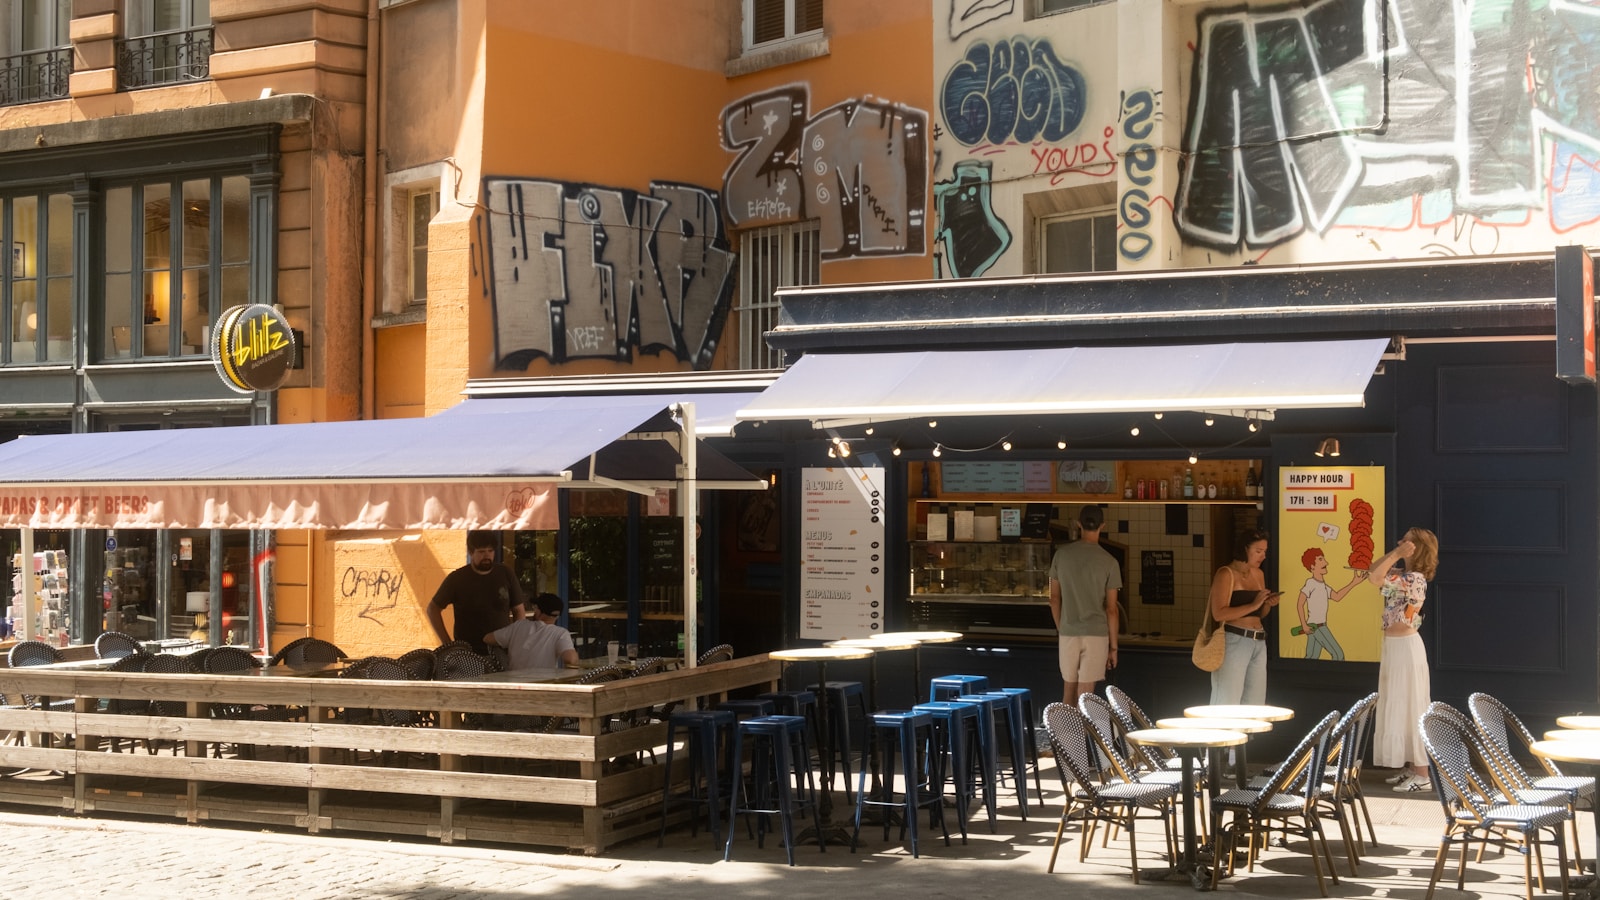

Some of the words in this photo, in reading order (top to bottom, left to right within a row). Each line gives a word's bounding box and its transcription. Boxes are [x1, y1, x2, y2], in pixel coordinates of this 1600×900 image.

[233, 312, 289, 366] blitz
[1290, 474, 1318, 483] HAPPY
[1320, 474, 1344, 483] HOUR
[40, 496, 49, 515] &
[55, 496, 99, 515] CRAFT
[105, 495, 149, 515] BEERS
[1290, 496, 1304, 505] 17H
[1313, 496, 1329, 505] 19H
[805, 530, 832, 541] MENUS
[805, 588, 852, 600] EMPANADAS
